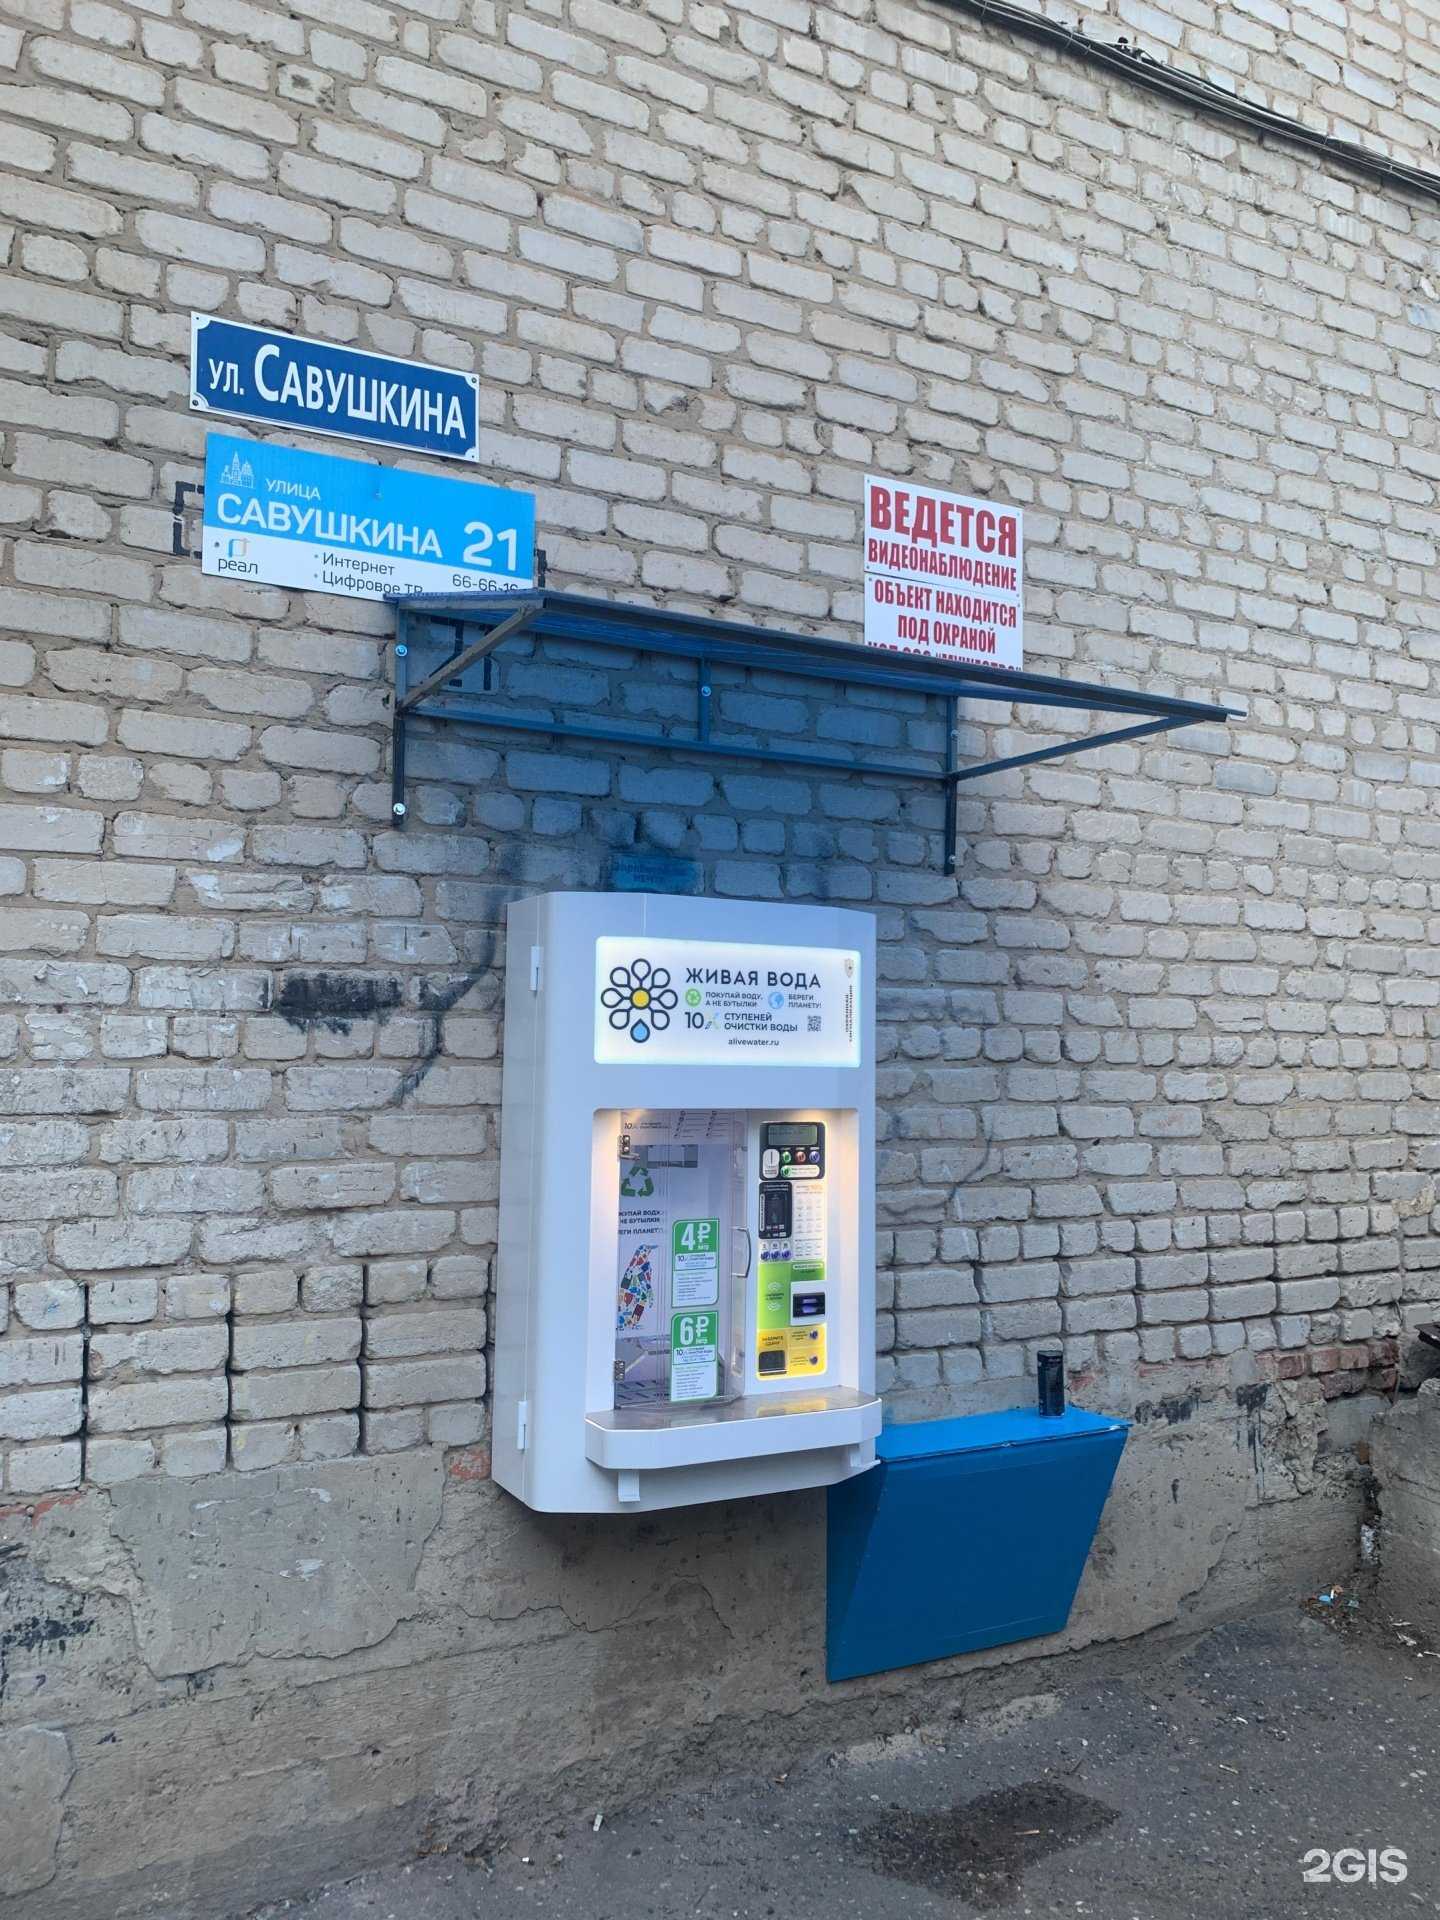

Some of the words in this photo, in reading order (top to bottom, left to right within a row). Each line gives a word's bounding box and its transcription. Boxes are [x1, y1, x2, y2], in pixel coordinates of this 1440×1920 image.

[265, 478, 321, 501] УЛИЦА
[216, 493, 444, 559] САВУШКИНА
[462, 521, 518, 572] 21
[870, 485, 1017, 559] ВЕДЕТСЯ
[217, 557, 259, 575] реал
[323, 551, 395, 577] Интернет
[868, 538, 1017, 592] ВИДЕОНАБЛЮДЕНИЕ
[322, 571, 401, 595] Цифровое
[874, 579, 933, 612] ОБЪЕКТ
[936, 590, 1017, 628] НАХОДИТСЯ
[897, 614, 930, 646] ПОД
[934, 621, 996, 654] ОХРАНОЙ
[685, 967, 759, 986] ЖИВАЯ
[767, 972, 822, 989] ВОДА
[705, 991, 741, 1000] ПОКУПАЙ
[788, 993, 814, 1001] БЕРЕГИ
[684, 1011, 705, 1030] 10
[724, 1012, 773, 1022] СТУПЕНЕЙ
[724, 1022, 768, 1032] ОЧИСТКИ
[770, 1024, 798, 1033] ВОДЫ
[728, 1038, 780, 1047] alivewater.ru
